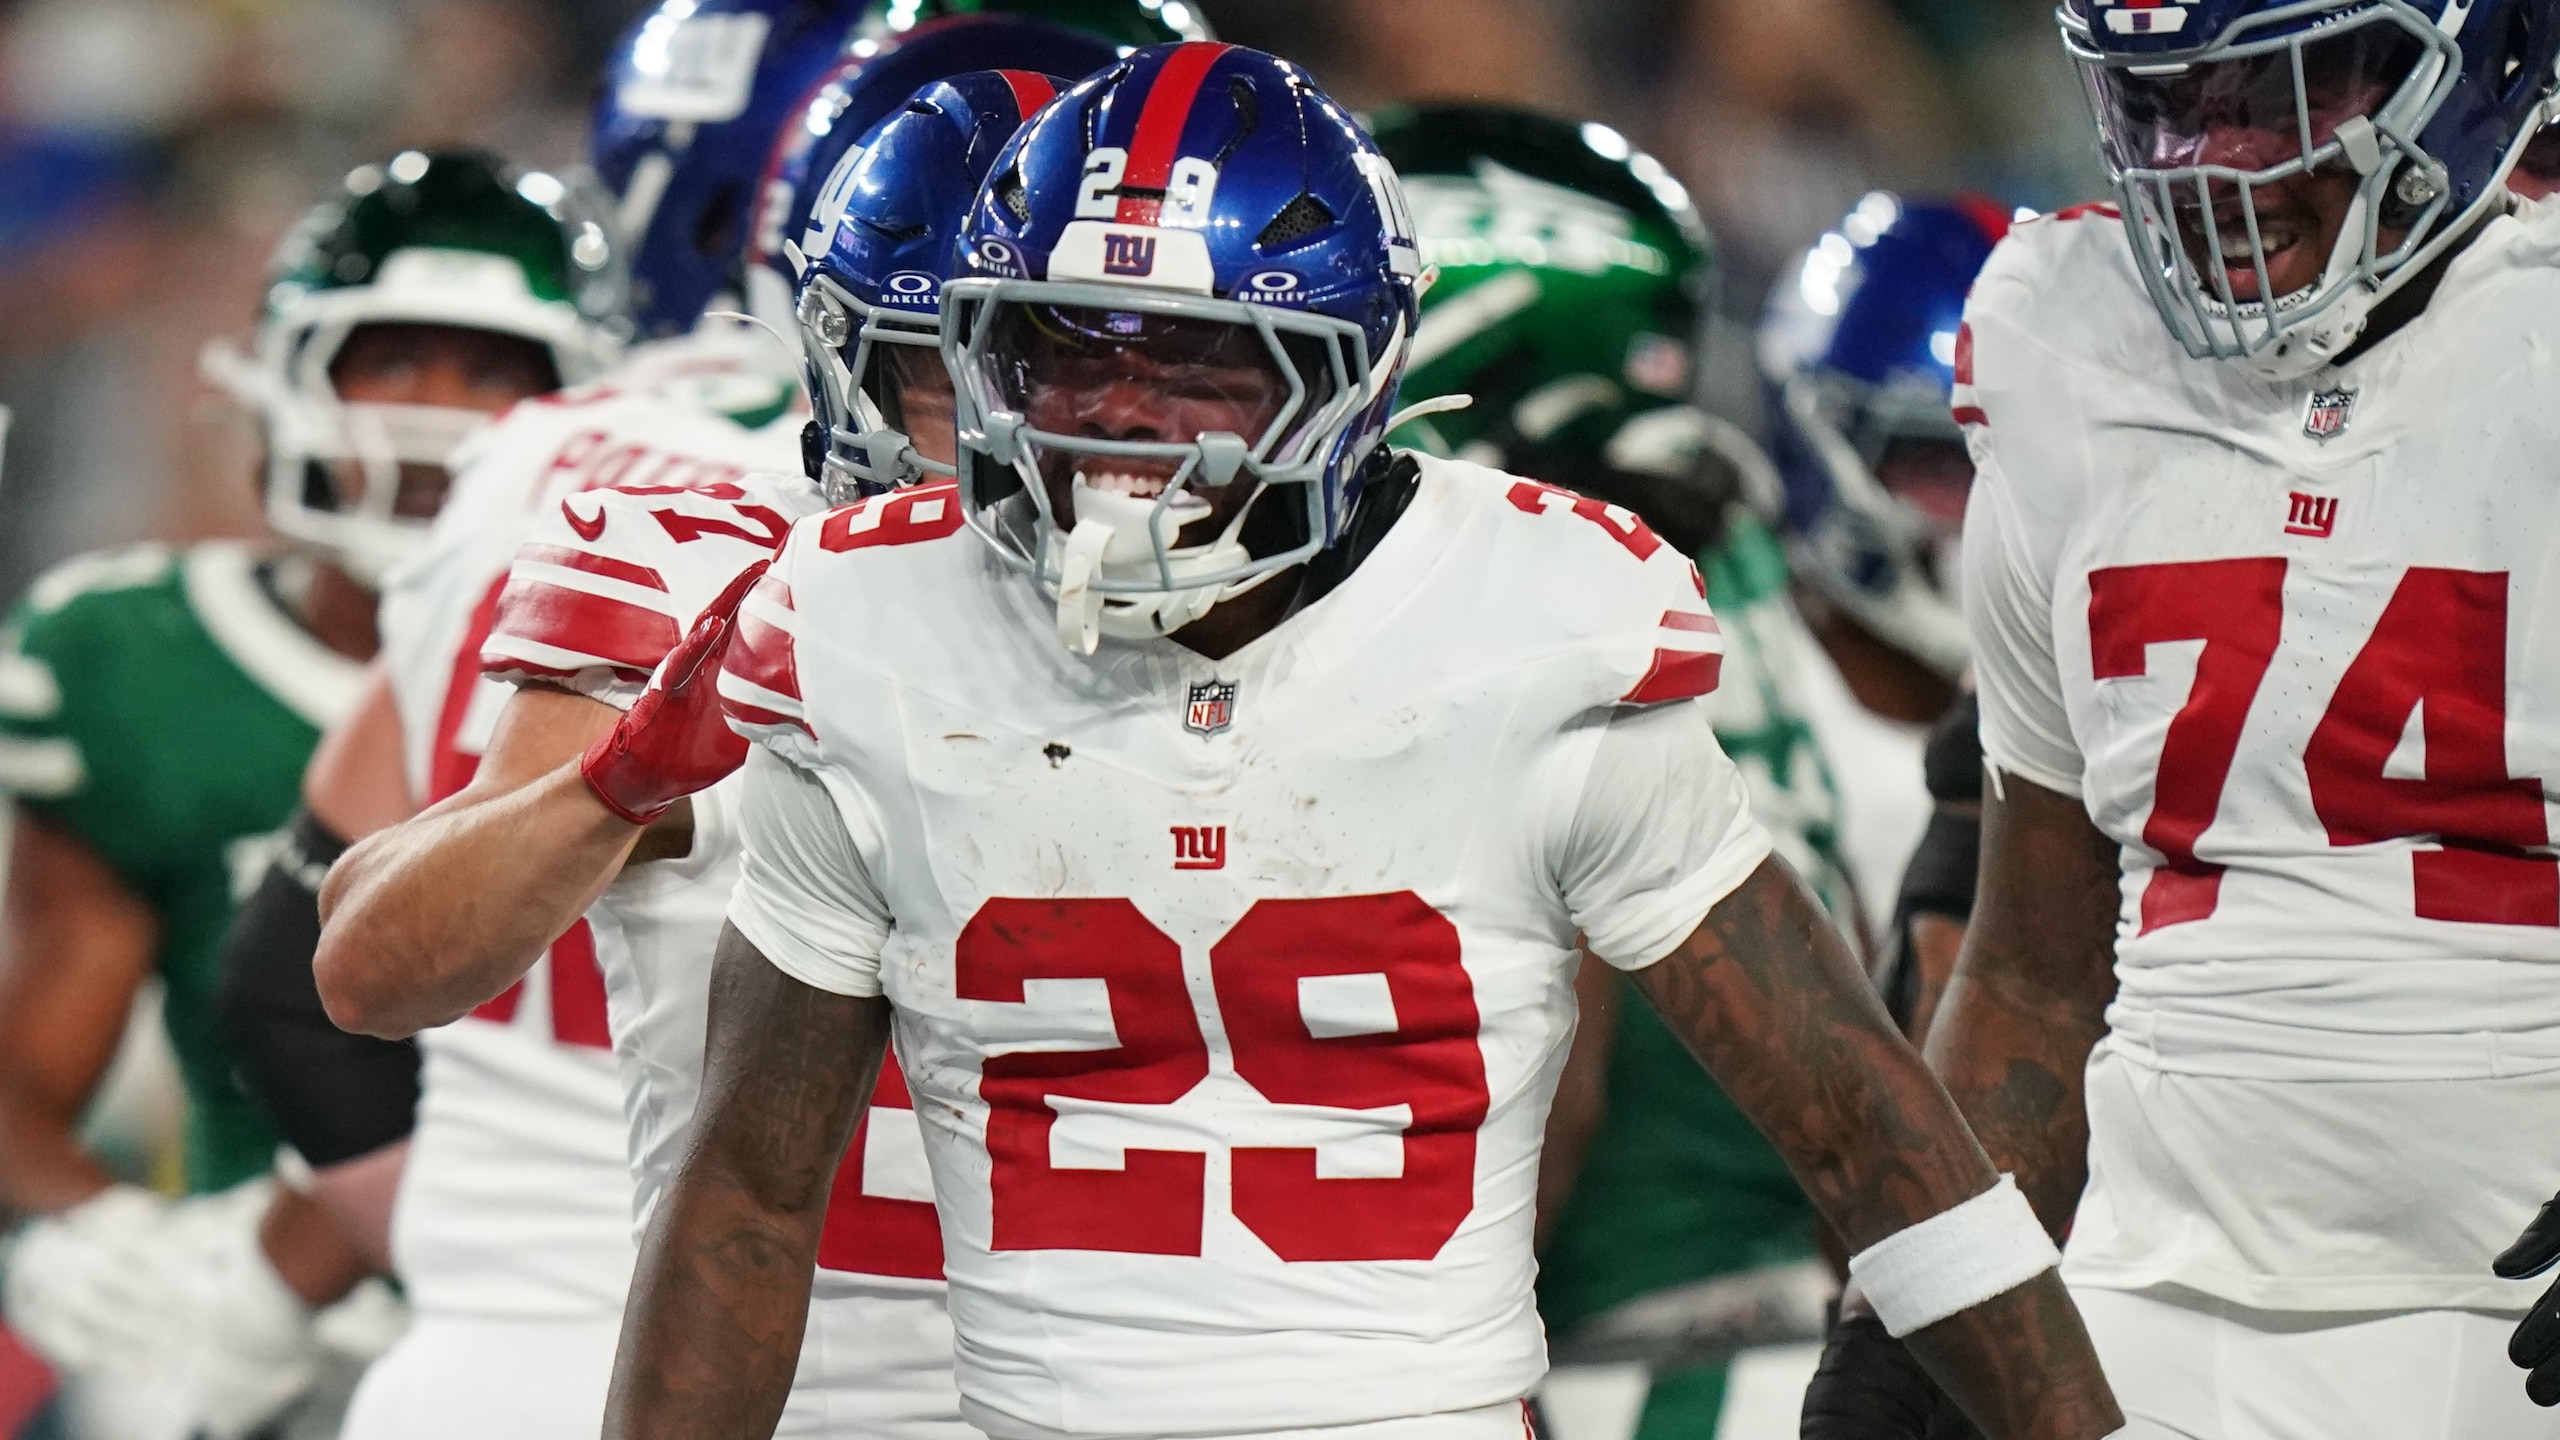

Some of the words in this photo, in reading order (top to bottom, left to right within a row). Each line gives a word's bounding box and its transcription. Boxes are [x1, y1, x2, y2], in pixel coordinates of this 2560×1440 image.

[1238, 291, 1306, 303] OAKLEY
[2310, 409, 2342, 431] NFL
[1191, 702, 1227, 727] NFL
[2088, 556, 2560, 937] 74
[956, 890, 1490, 1262] 29
